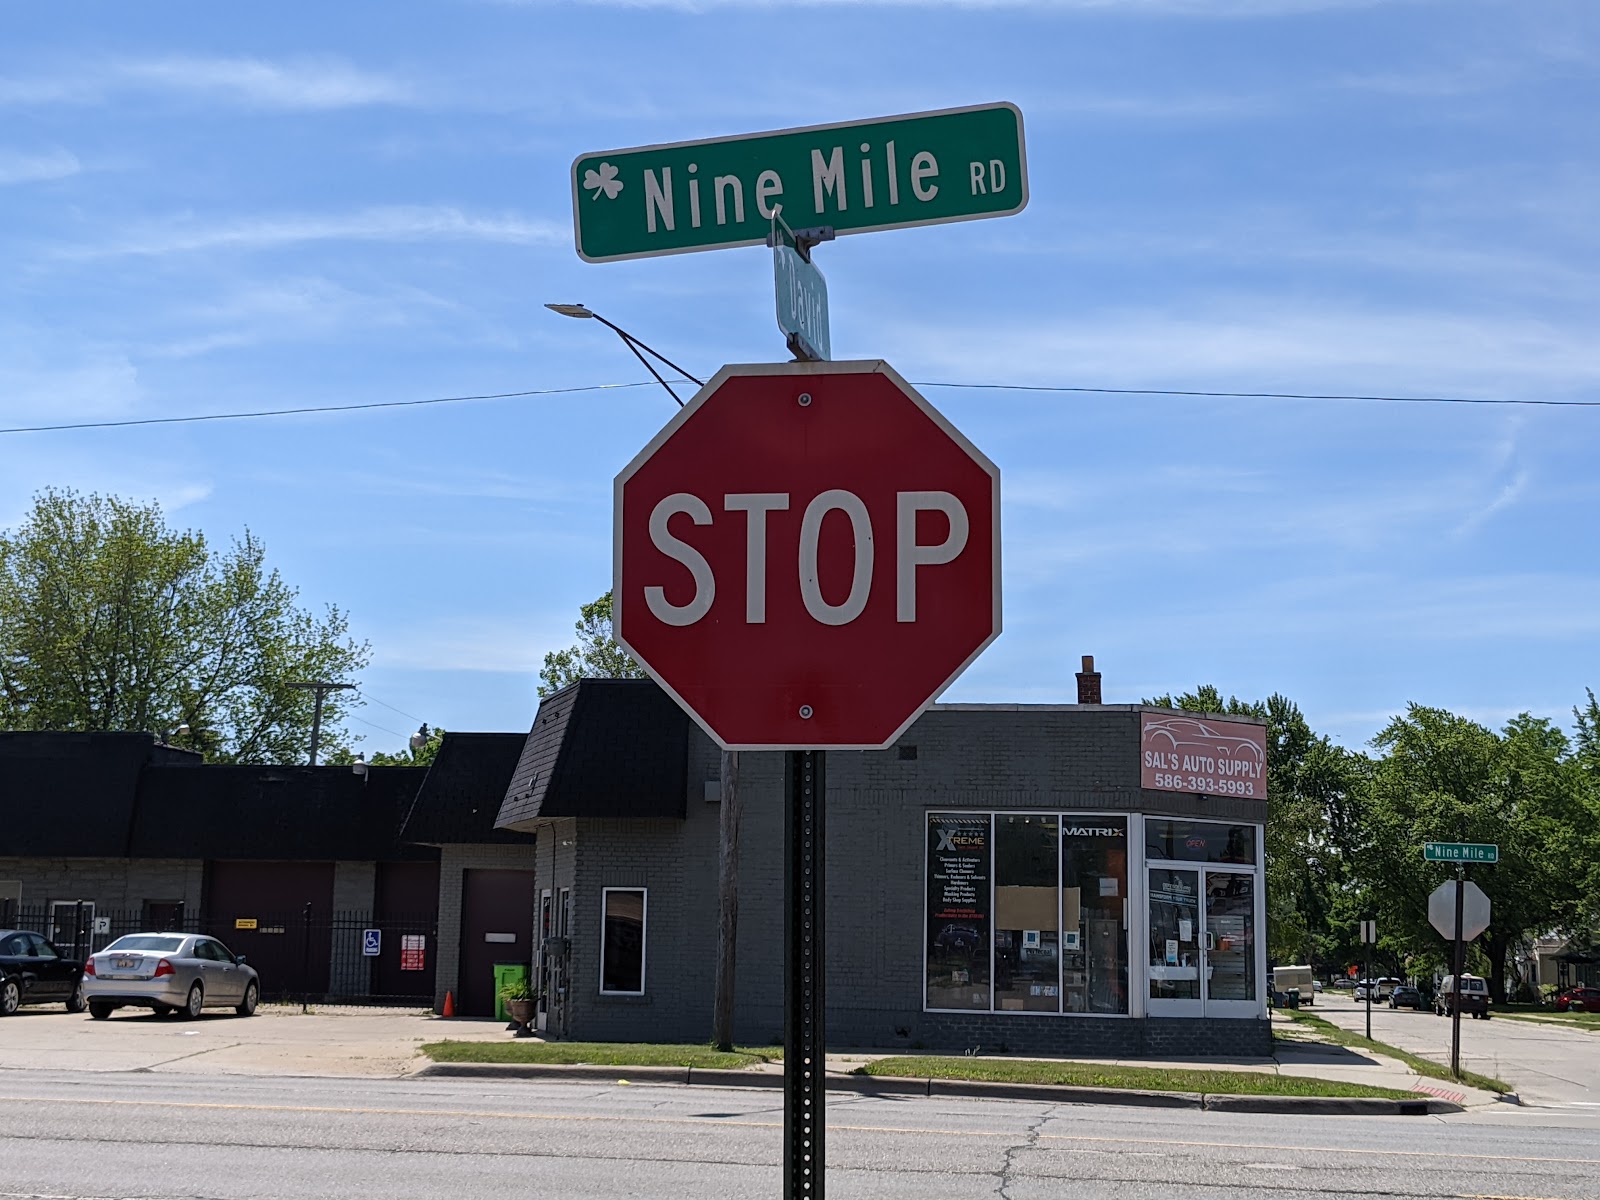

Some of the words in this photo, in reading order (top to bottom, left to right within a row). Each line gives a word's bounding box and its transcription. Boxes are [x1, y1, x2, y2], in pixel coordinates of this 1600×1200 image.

[643, 162, 785, 234] Nine
[810, 140, 940, 214] Mile
[969, 159, 1007, 195] RD
[788, 252, 824, 352] David
[643, 488, 970, 627] STOP
[1144, 750, 1179, 771] SAL'S
[1182, 754, 1215, 774] AUTO
[1217, 758, 1263, 779] SUPPLY
[1155, 773, 1254, 796] 586-393-5993
[935, 829, 985, 851] XTREME
[1062, 827, 1125, 837] MATRIX
[1186, 839, 1206, 848] OPEN
[1435, 845, 1459, 858] Nine
[1462, 846, 1484, 859] Mile
